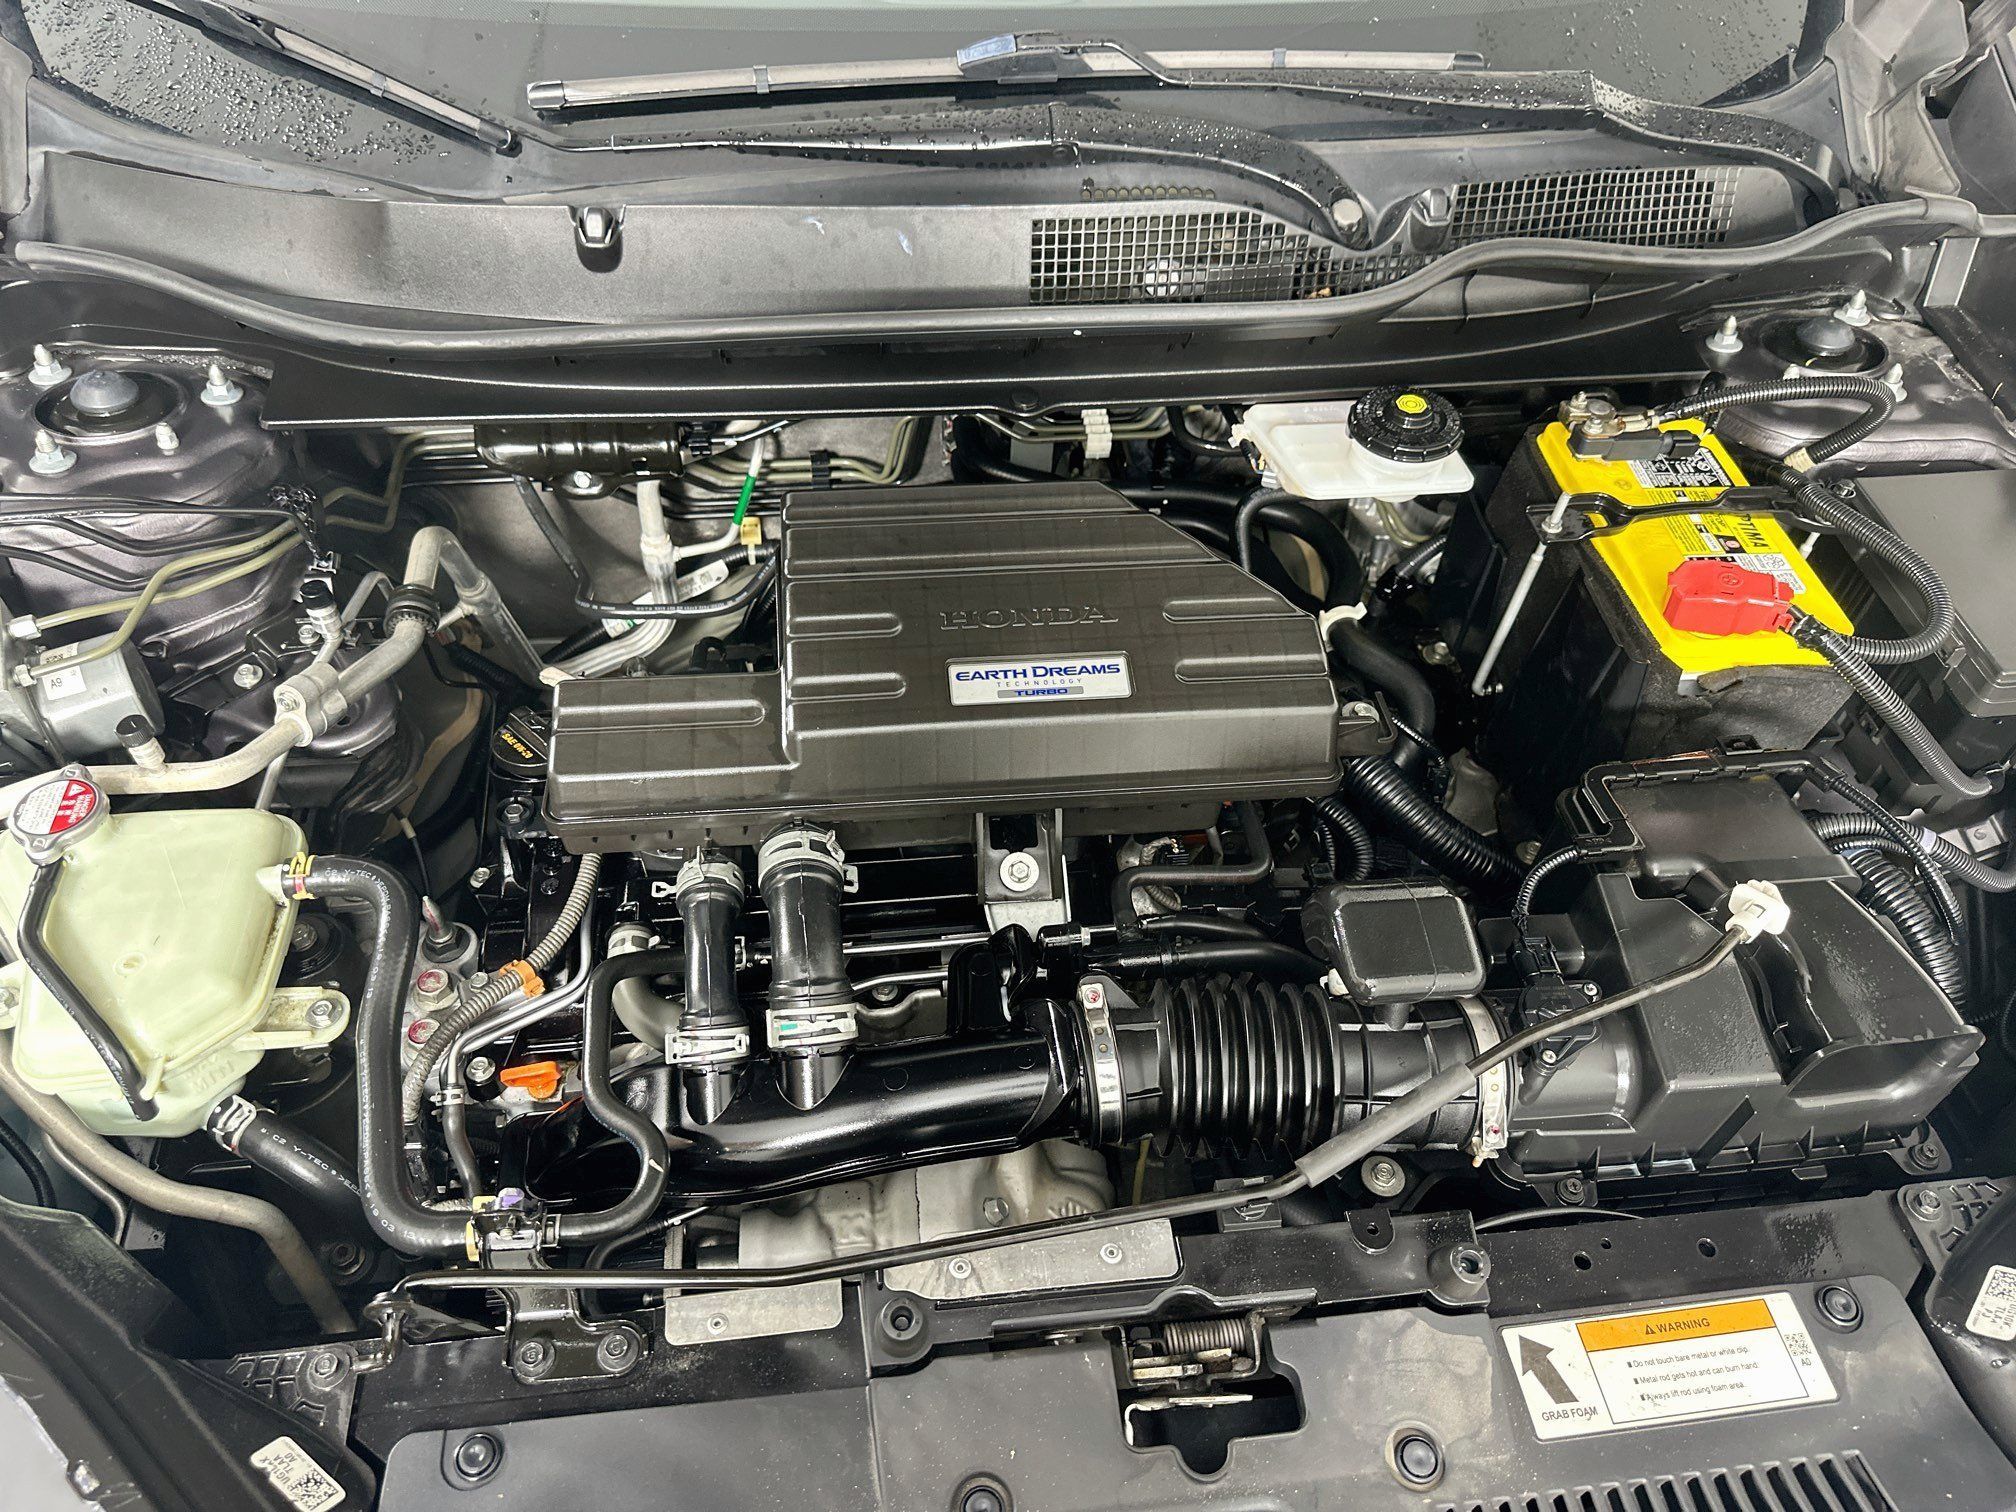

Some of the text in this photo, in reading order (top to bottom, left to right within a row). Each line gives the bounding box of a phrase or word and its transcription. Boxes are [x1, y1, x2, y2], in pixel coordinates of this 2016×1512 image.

[939, 604, 1119, 630] HONDA
[956, 663, 1121, 681] EARTH DREAMS
[997, 677, 1083, 687] TECHNOLOGY
[1014, 687, 1068, 696] TURBO
[501, 732, 518, 745] SAE
[293, 1145, 330, 1171] Y-TEC
[1656, 1317, 1711, 1333] WARNING
[1633, 1359, 1643, 1368] Do
[1644, 1358, 1655, 1366] not
[1657, 1355, 1674, 1365] touch
[1675, 1353, 1690, 1362] bare
[1691, 1351, 1709, 1360] metal
[1710, 1350, 1717, 1358] or
[1719, 1348, 1735, 1357] white
[1639, 1375, 1658, 1384] Metal
[1659, 1374, 1671, 1382] rod
[1671, 1372, 1686, 1381] gets
[1686, 1370, 1697, 1378] hot
[1698, 1368, 1711, 1377] and
[1712, 1367, 1723, 1375] can
[1725, 1364, 1740, 1373] burn
[1646, 1391, 1670, 1401] Always
[1671, 1389, 1680, 1398] lift
[1680, 1388, 1692, 1397] rod
[1693, 1385, 1710, 1395] using
[1711, 1383, 1728, 1392] foam
[1541, 1405, 1599, 1422] GRAB FOAM
